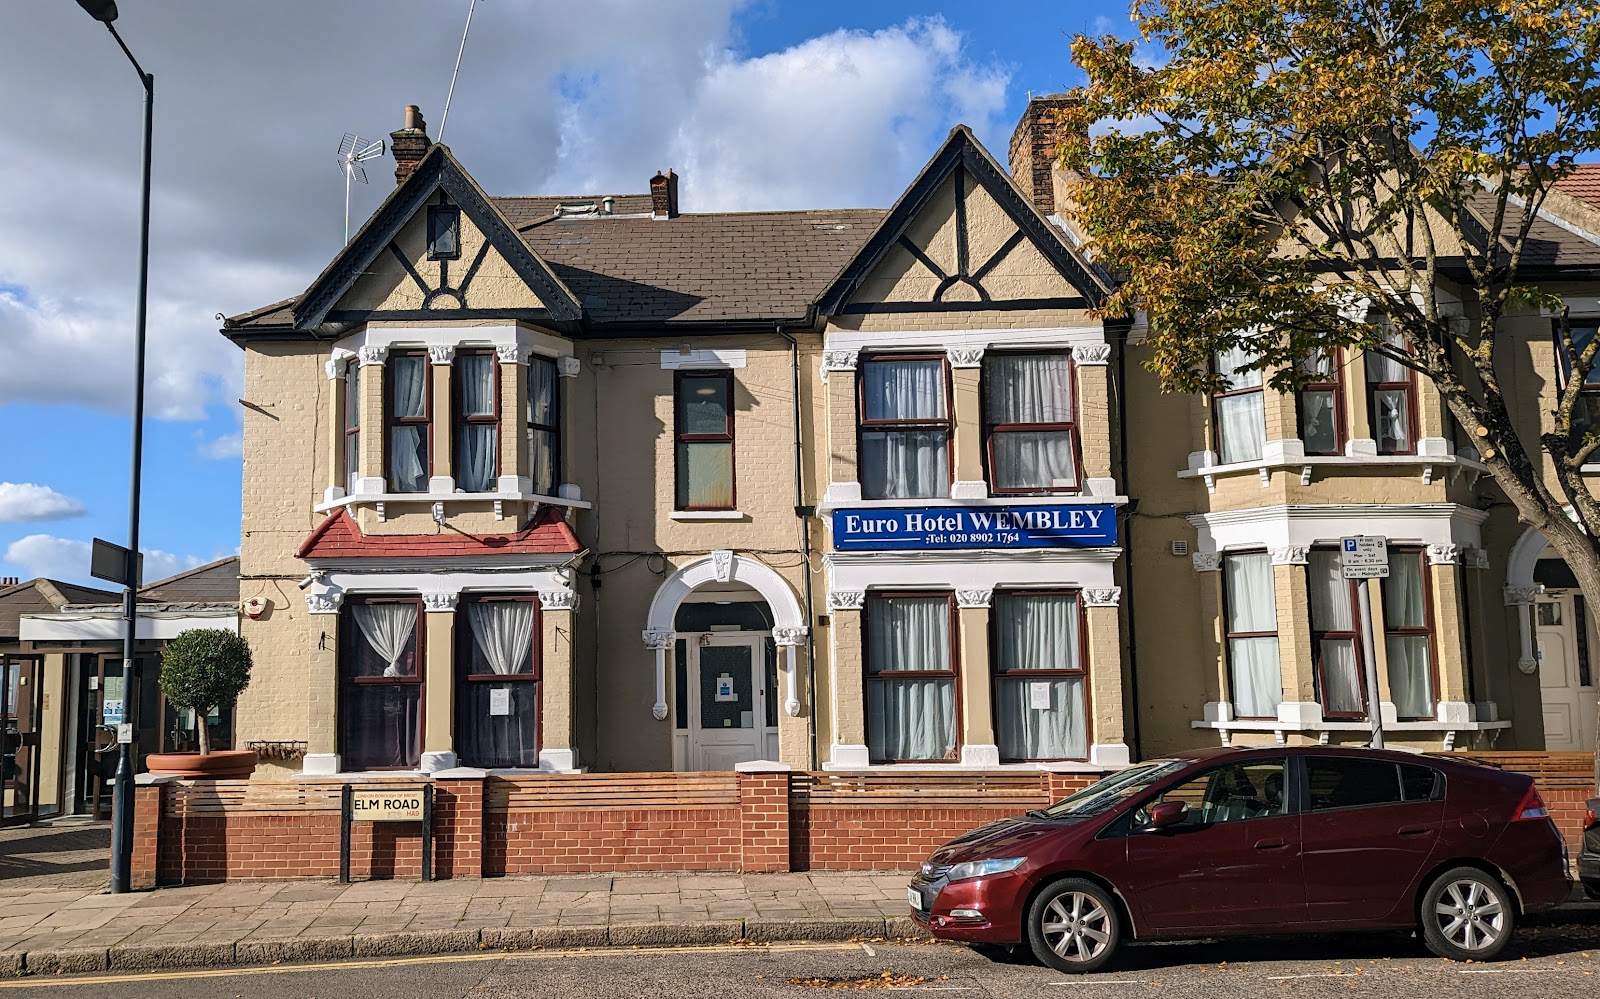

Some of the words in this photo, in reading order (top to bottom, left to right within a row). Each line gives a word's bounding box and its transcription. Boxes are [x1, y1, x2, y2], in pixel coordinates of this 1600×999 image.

[845, 515, 899, 533] Euro
[904, 513, 963, 532] Hotel
[969, 510, 1103, 530] WEMBLEY
[928, 534, 947, 543] Tel:
[949, 534, 968, 543] 020
[970, 533, 993, 542] 8902
[997, 533, 1019, 542] 1764
[1346, 541, 1355, 551] P
[354, 800, 379, 810] ELM
[384, 800, 420, 810] ROAD
